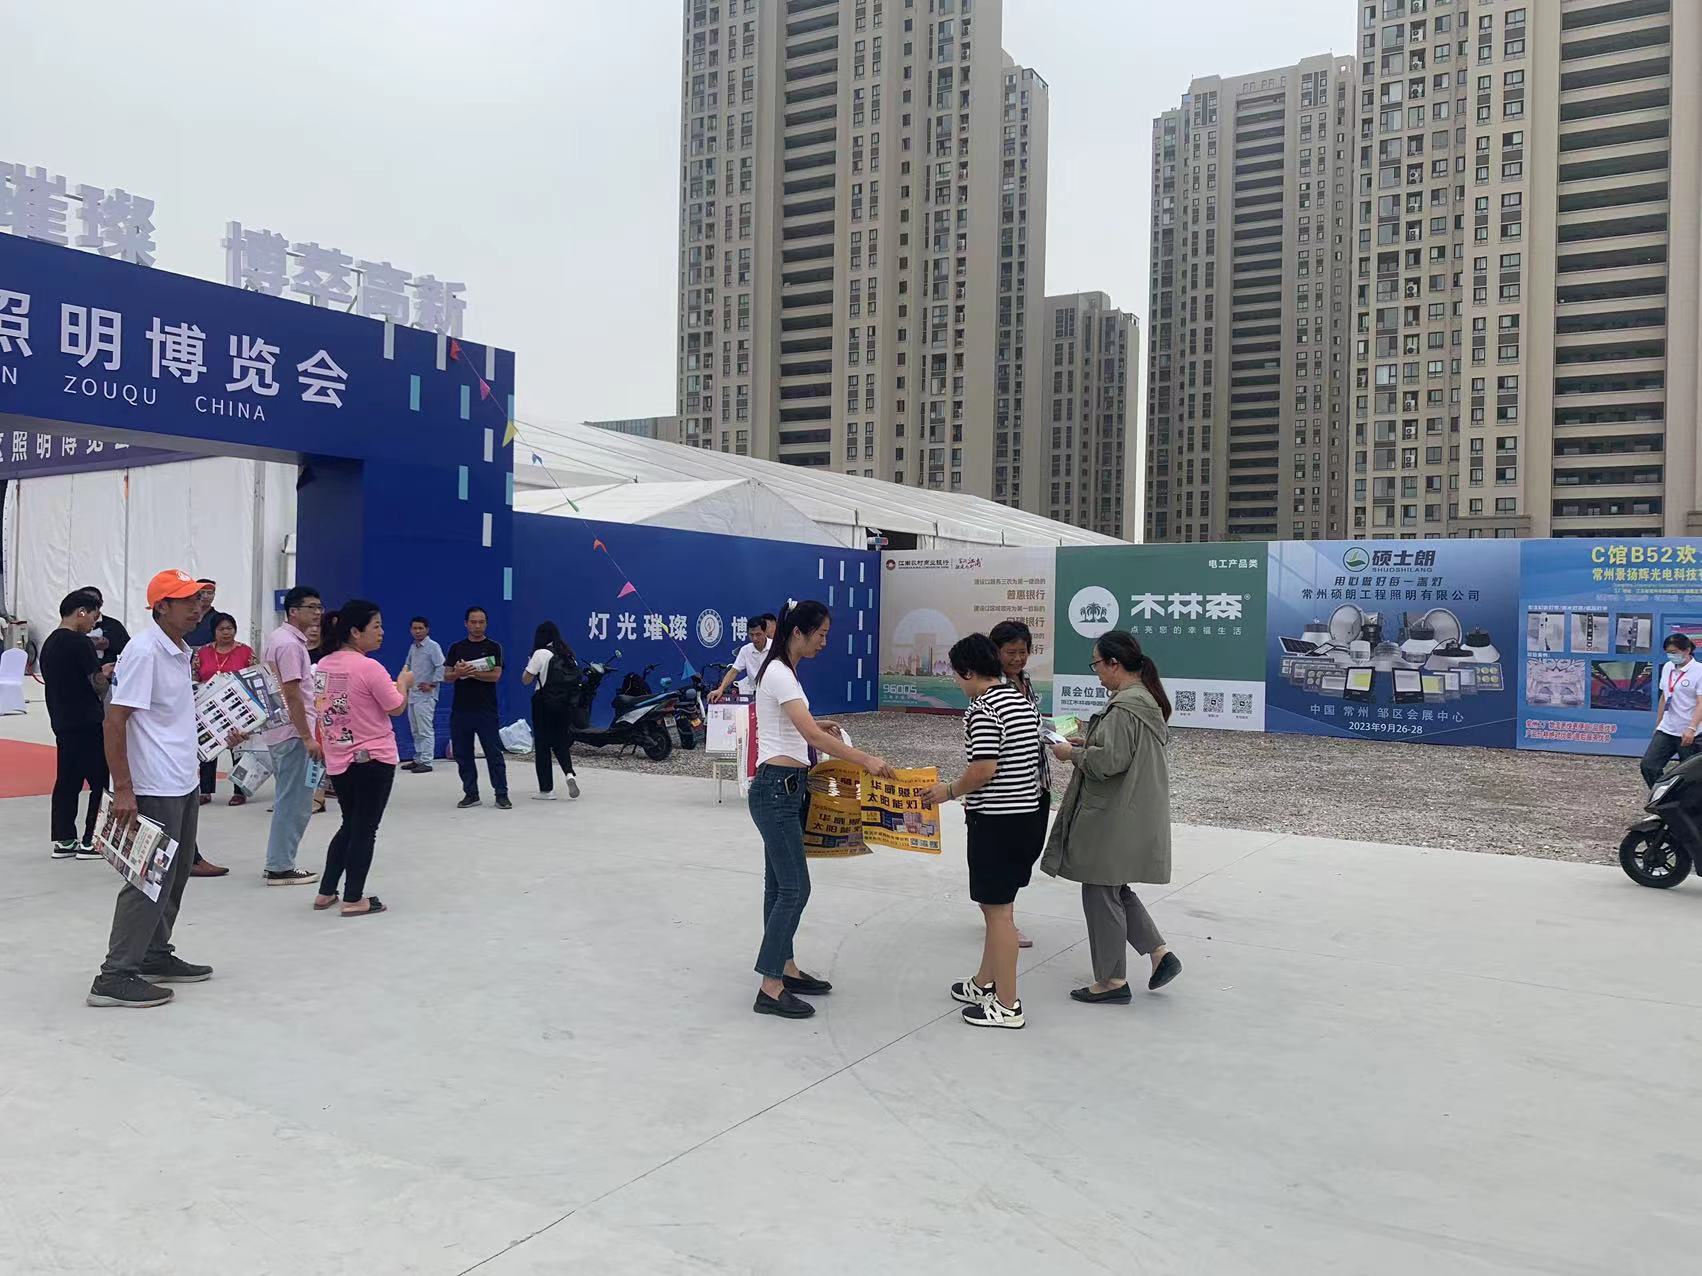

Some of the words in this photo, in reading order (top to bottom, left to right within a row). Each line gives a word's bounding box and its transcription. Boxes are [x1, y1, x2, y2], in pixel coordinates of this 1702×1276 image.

[63, 375, 157, 406] ZOUQU
[195, 396, 266, 421] CHINA
[1372, 550, 1436, 567] 硕士朗
[1592, 545, 1702, 564] C馆B52欢
[1208, 559, 1259, 569] 电工产品类
[1593, 568, 1702, 581] 常州景扬辉光电科技
[1335, 576, 1444, 587] 用心做好每一盏灯
[1007, 589, 1046, 600] 普惠银行
[1302, 589, 1480, 602] 常州硕朗工程照明有限公司
[1131, 592, 1243, 620] 木林森
[588, 611, 688, 642] 灯光璀璨
[1131, 626, 1242, 636] 点亮您的幸福生活
[883, 684, 917, 695] 96005
[1310, 704, 1335, 716] 中国
[1343, 706, 1369, 718] 常州
[1377, 708, 1464, 723] 邹区会展中心
[1349, 722, 1423, 735] 2023年9月26-28
